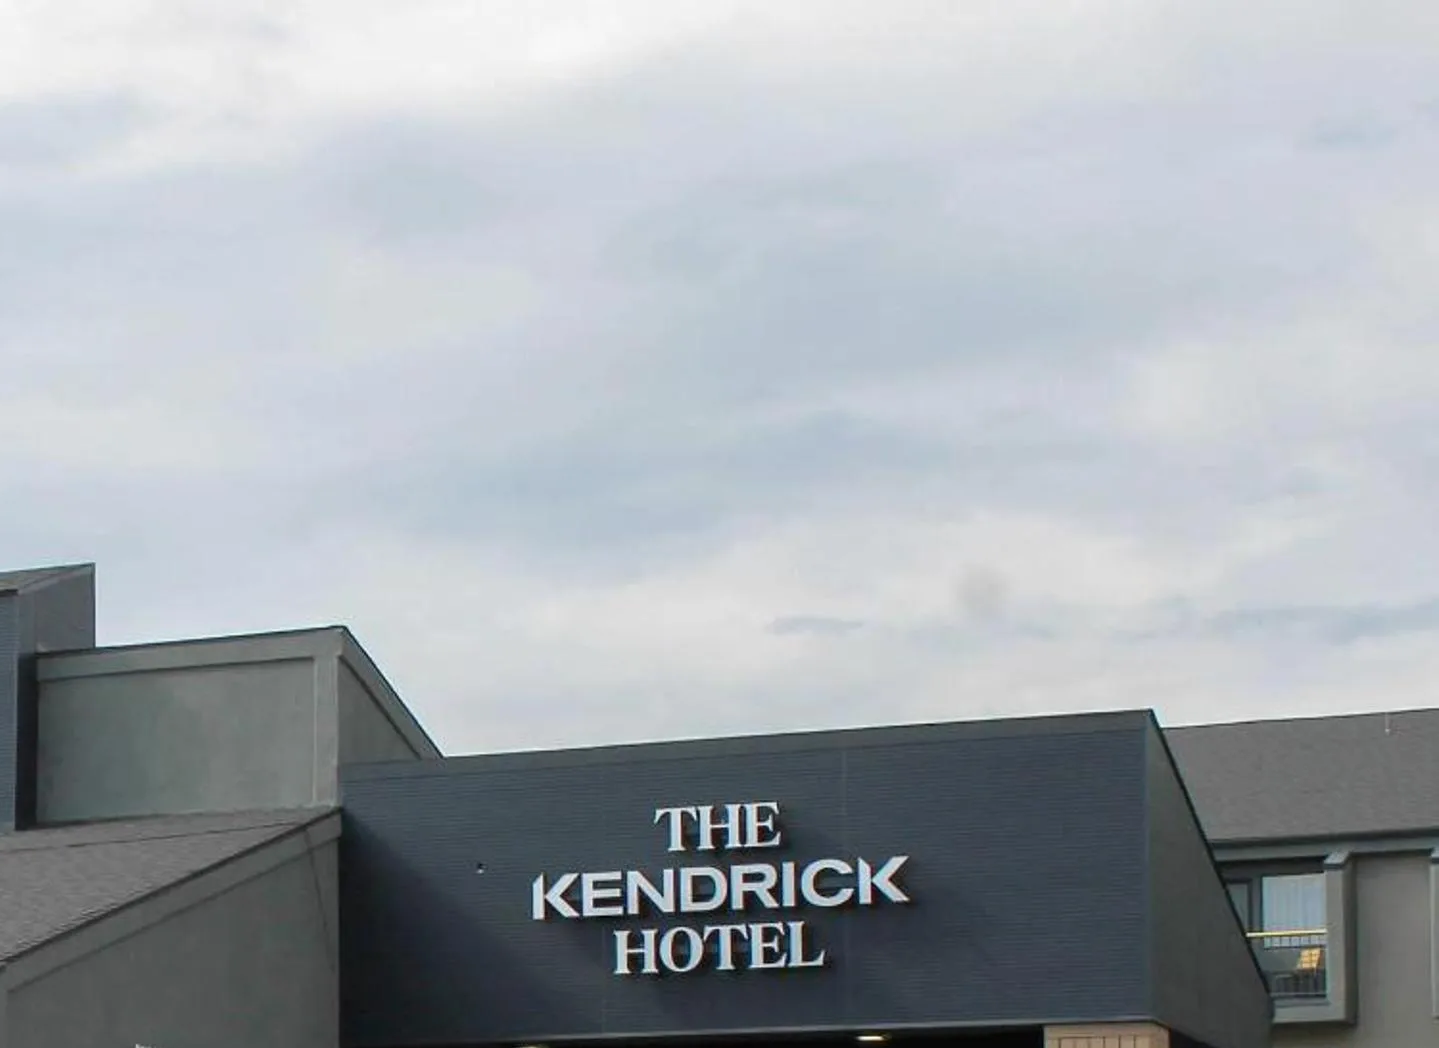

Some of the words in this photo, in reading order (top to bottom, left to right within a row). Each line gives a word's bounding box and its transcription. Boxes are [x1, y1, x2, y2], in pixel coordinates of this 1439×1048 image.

[653, 801, 782, 852] THE
[532, 855, 910, 920] KENDRICK
[613, 920, 826, 975] HOTEL
